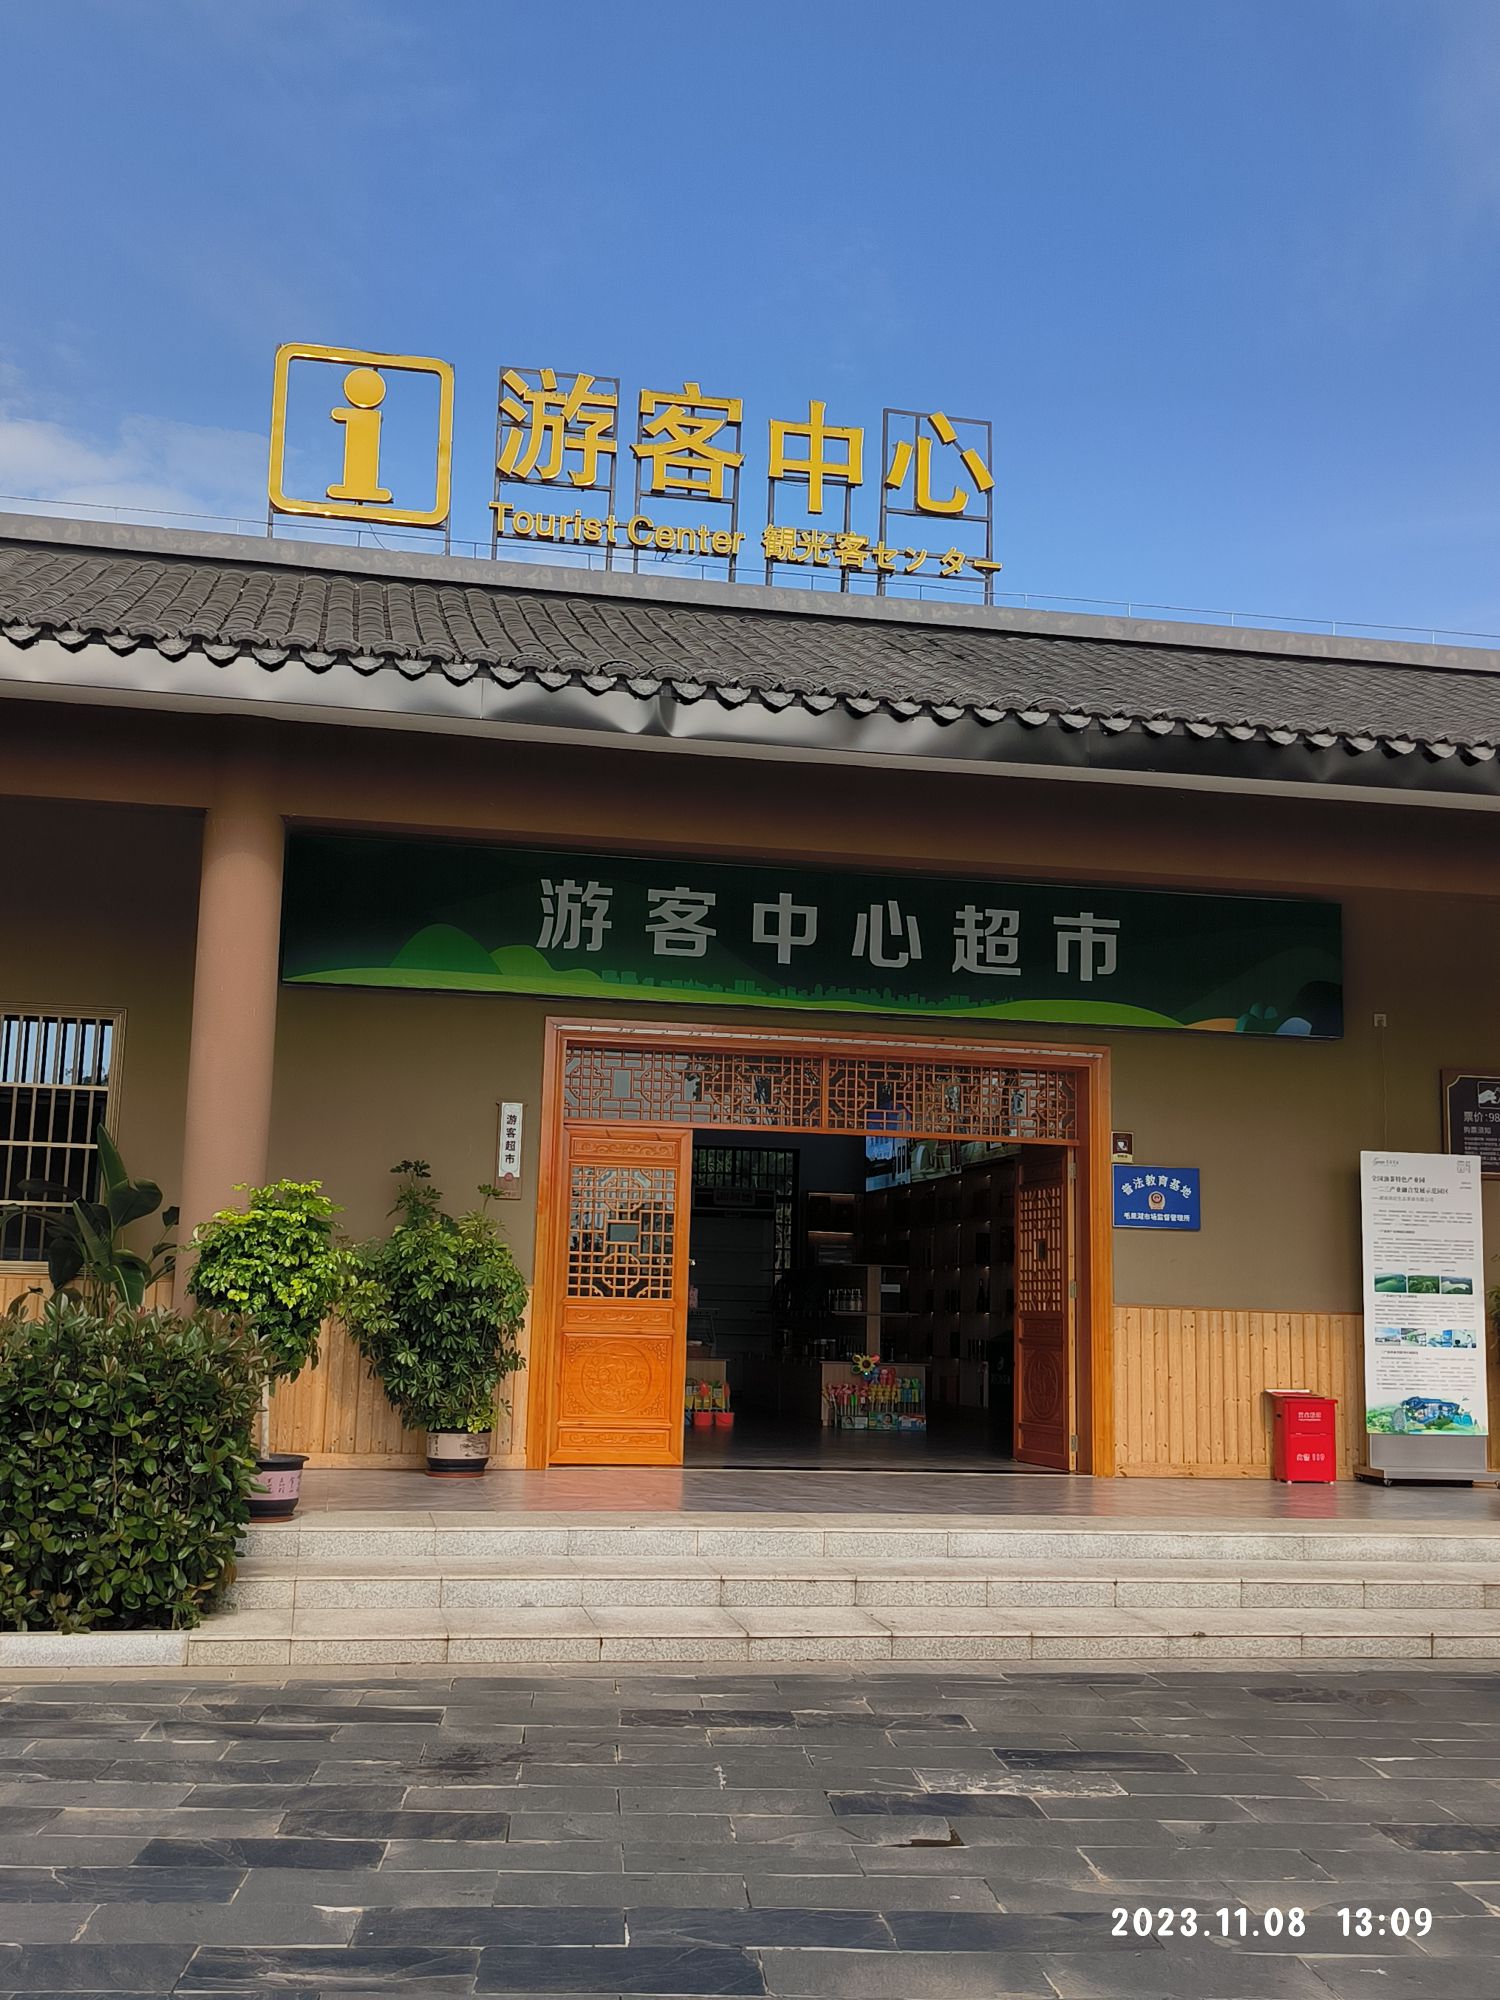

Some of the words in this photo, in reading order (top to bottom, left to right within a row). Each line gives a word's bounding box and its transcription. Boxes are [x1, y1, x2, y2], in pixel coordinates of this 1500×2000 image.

[496, 367, 995, 516] 游客中心
[488, 501, 619, 544] Tourist
[627, 514, 746, 555] Center
[761, 523, 1003, 577] 観光客センター
[535, 877, 1122, 982] 游客中心超市
[504, 1114, 518, 1164] 游客超市
[1121, 1174, 1192, 1199] 普法教育基地
